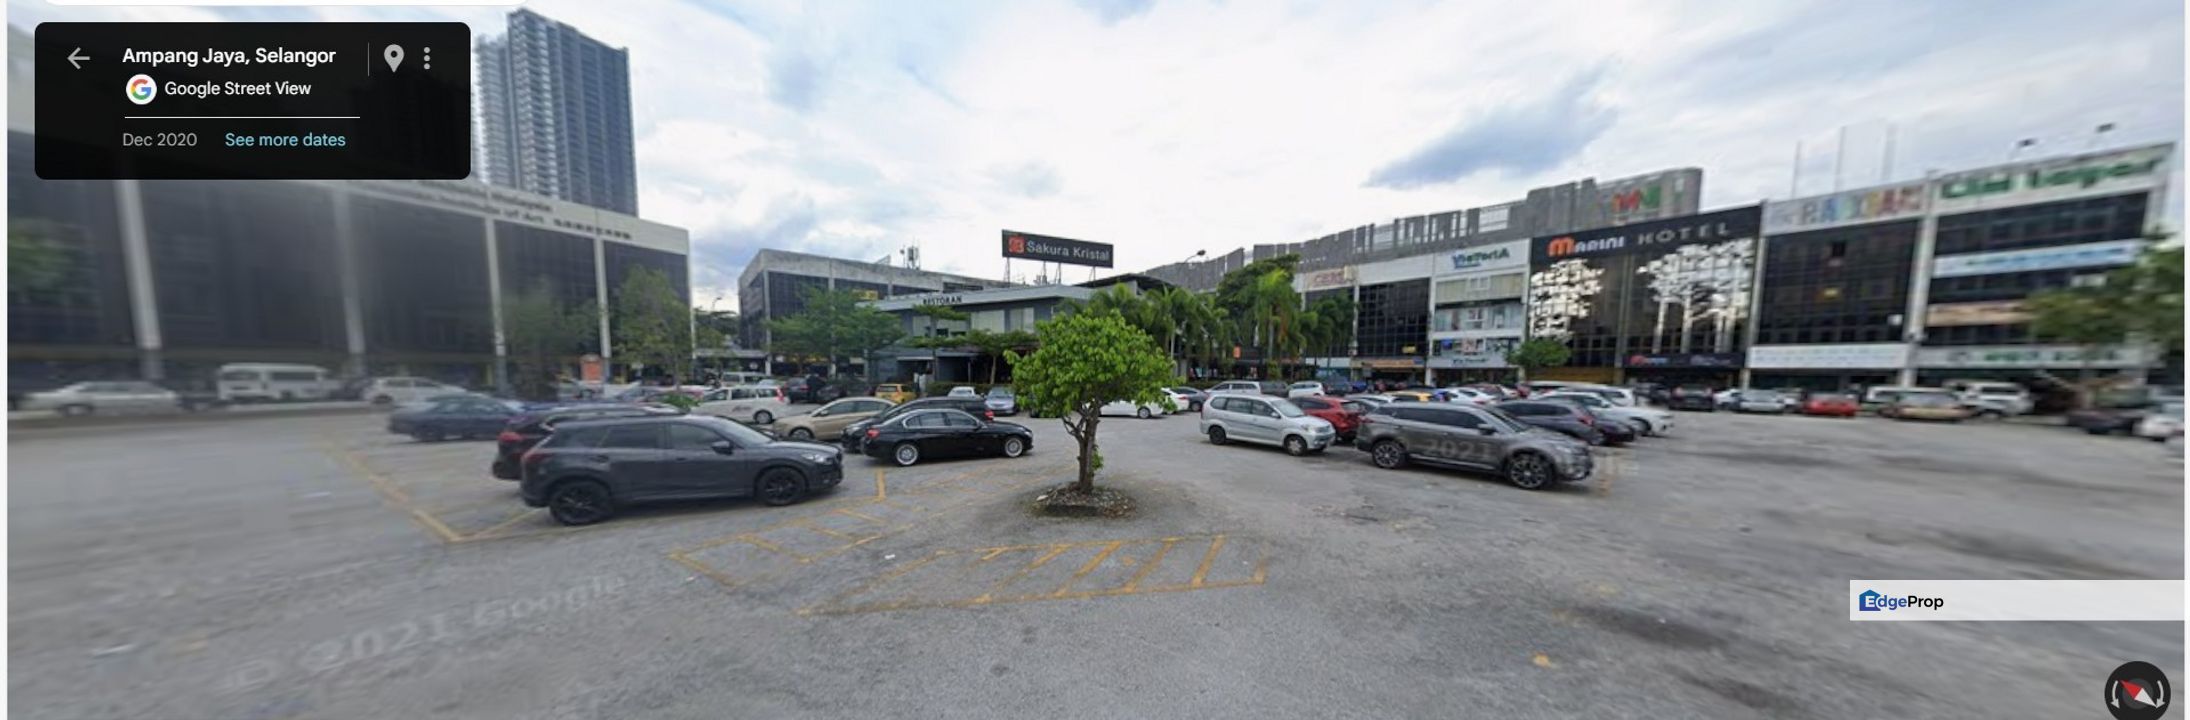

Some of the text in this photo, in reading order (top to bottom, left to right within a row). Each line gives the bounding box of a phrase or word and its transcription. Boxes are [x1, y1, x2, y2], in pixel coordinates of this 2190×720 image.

[1548, 221, 1730, 257] MARINI HOTEL
[1026, 240, 1110, 262] Sakura Kristal
[922, 295, 962, 306] RESTORAN
